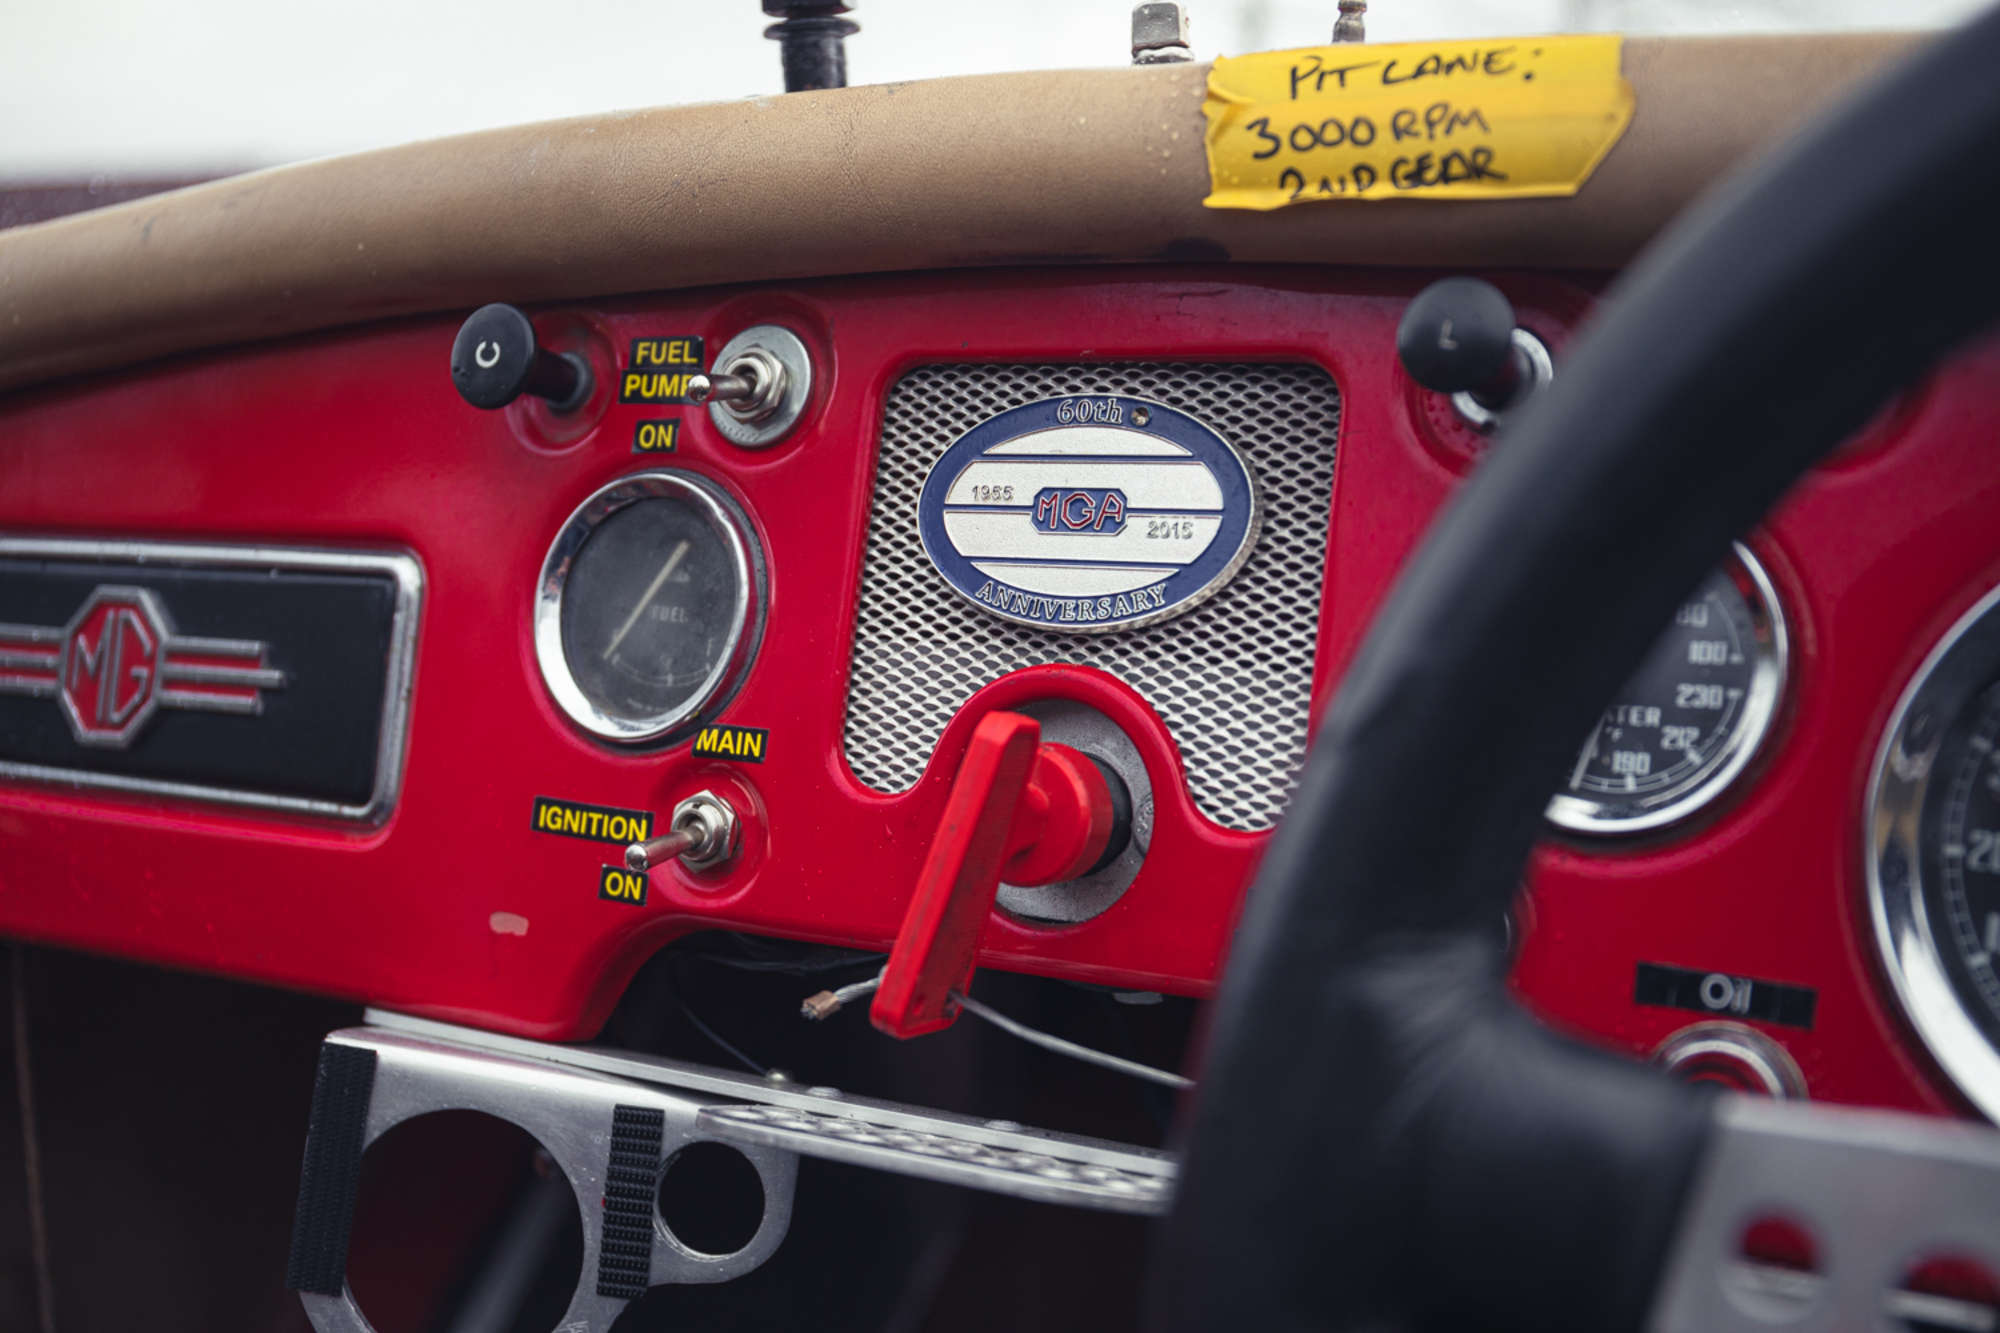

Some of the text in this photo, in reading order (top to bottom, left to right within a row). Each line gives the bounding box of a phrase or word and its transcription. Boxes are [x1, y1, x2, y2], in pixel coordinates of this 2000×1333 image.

[1289, 55, 1384, 100] PIT
[1246, 102, 1491, 160] 3000 RPM
[1388, 146, 1510, 190] GEAR
[635, 340, 699, 365] FUEL
[1056, 398, 1123, 424] 60th
[638, 424, 674, 448] ON
[1037, 490, 1123, 531] MGA
[1146, 519, 1194, 540] 2015
[975, 580, 1169, 621] ANNIVERSARY
[72, 607, 154, 725] MG
[1687, 640, 1729, 666] 100
[1675, 683, 1725, 710] 230
[696, 728, 762, 758] MAIN
[1660, 725, 1700, 750] 212
[538, 803, 647, 843] IGNITION
[604, 871, 642, 900] ON
